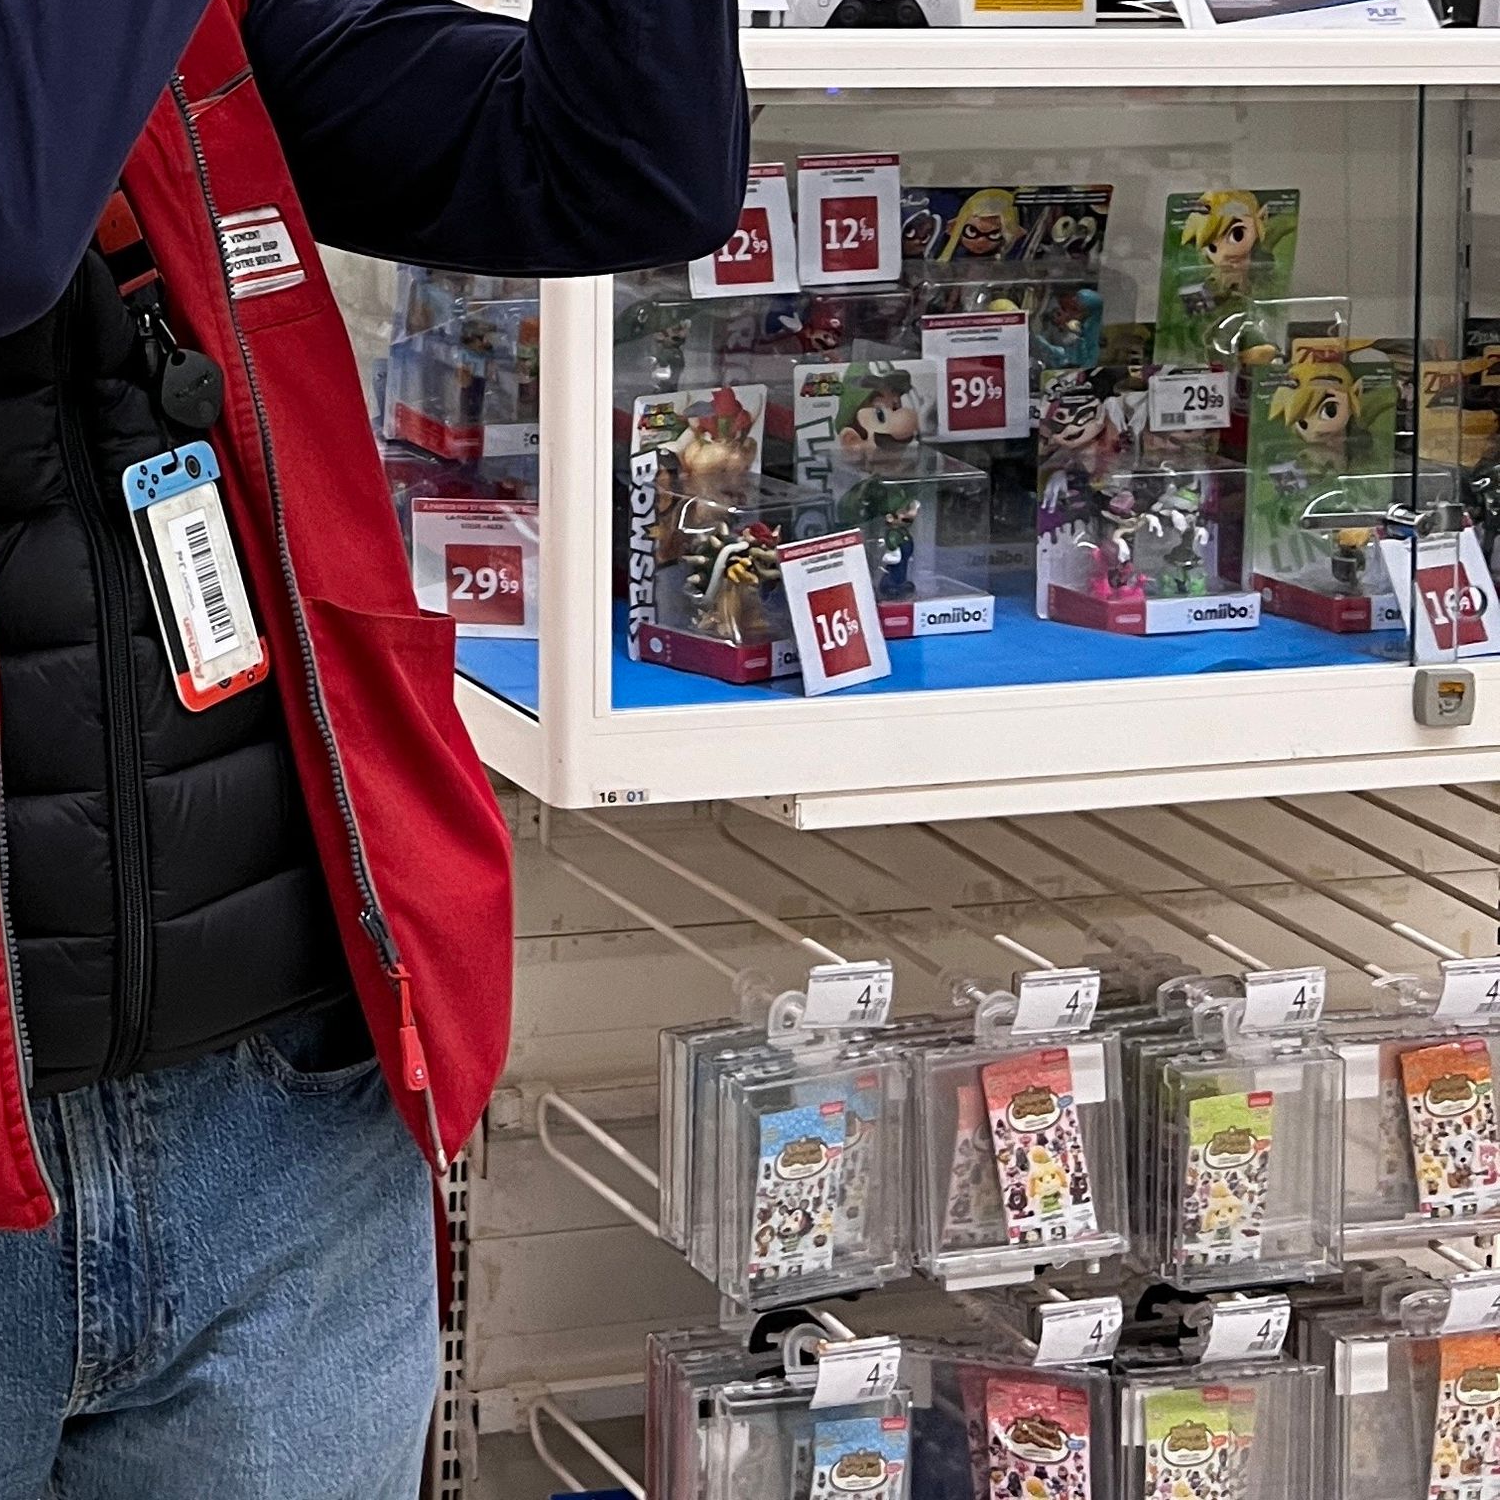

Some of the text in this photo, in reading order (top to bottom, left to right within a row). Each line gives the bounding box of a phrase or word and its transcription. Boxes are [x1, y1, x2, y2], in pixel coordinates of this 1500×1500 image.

[927, 606, 982, 625] amiibo
[1192, 602, 1250, 622] amiibo
[599, 790, 644, 803] 16 01
